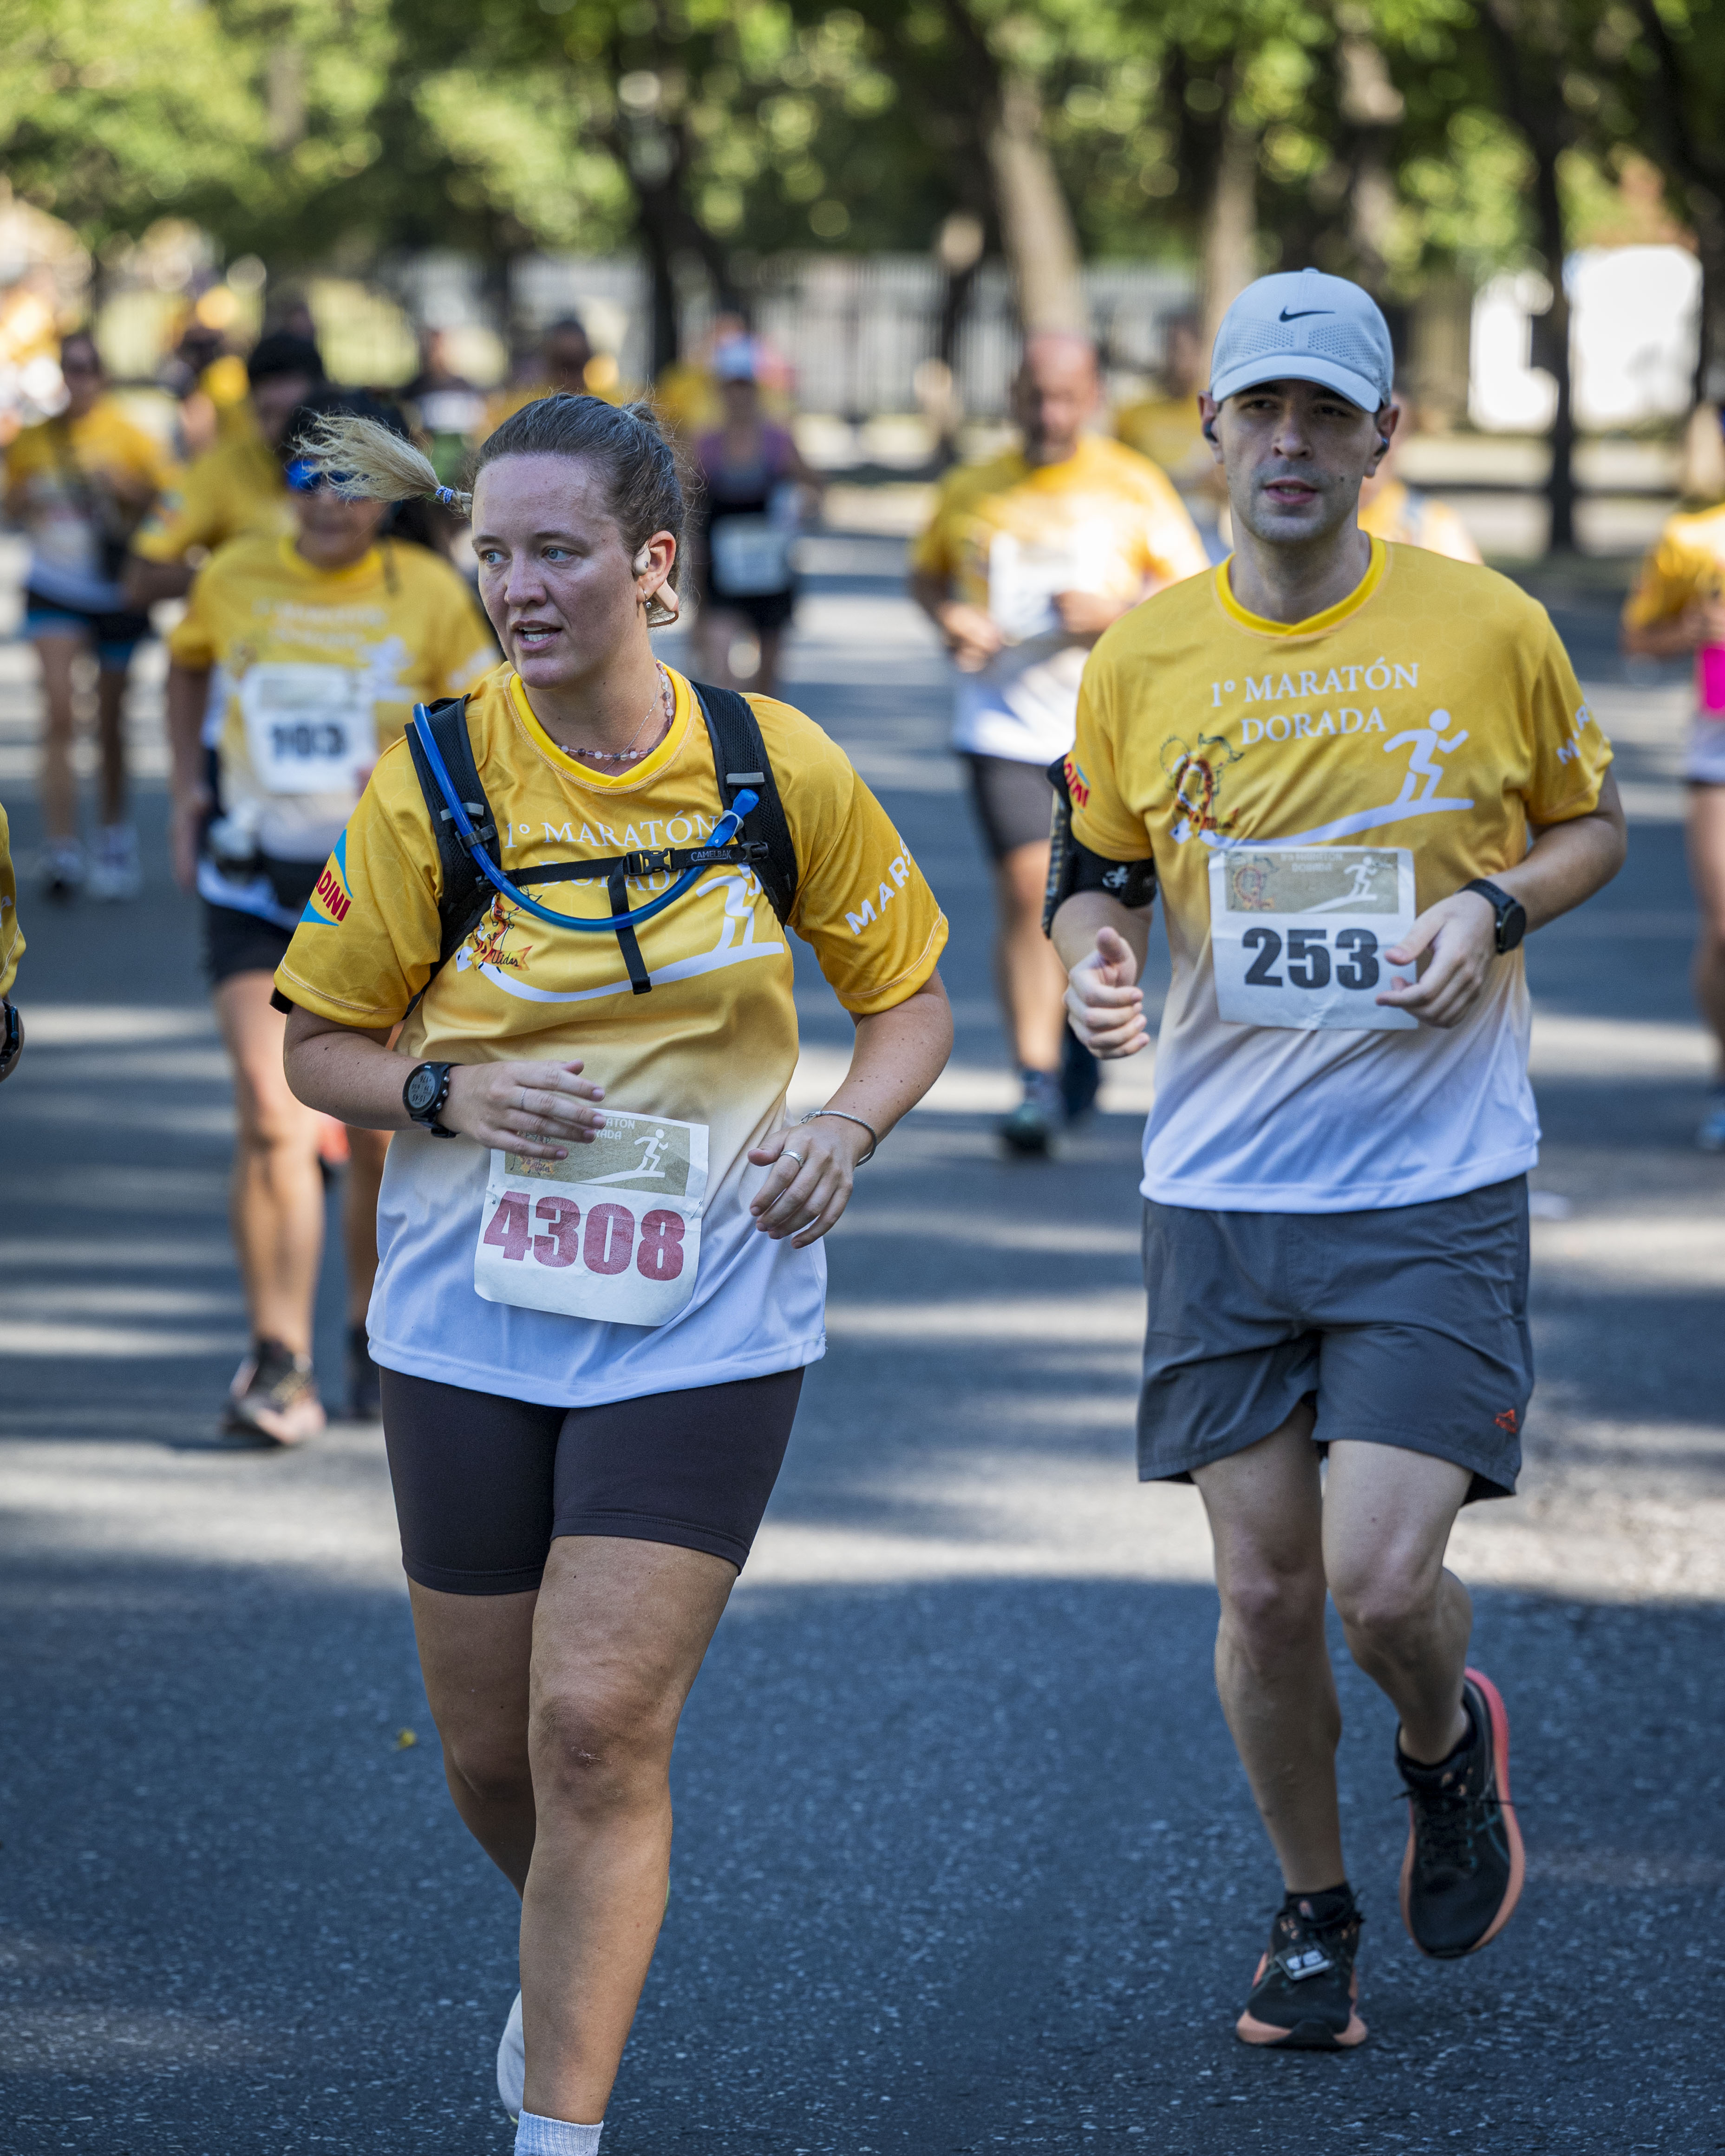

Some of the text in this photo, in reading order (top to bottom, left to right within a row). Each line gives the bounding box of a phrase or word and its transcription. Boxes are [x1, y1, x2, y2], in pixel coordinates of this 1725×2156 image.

[1243, 656, 1419, 703] MARATÓN
[1240, 706, 1387, 745] DORADA
[541, 810, 719, 849] MARATÓN
[691, 850, 732, 862] CAMELBAK
[316, 864, 352, 922] DINI
[1242, 927, 1379, 990] 253
[606, 1116, 635, 1130] ATON
[483, 1191, 686, 1281] 4308
